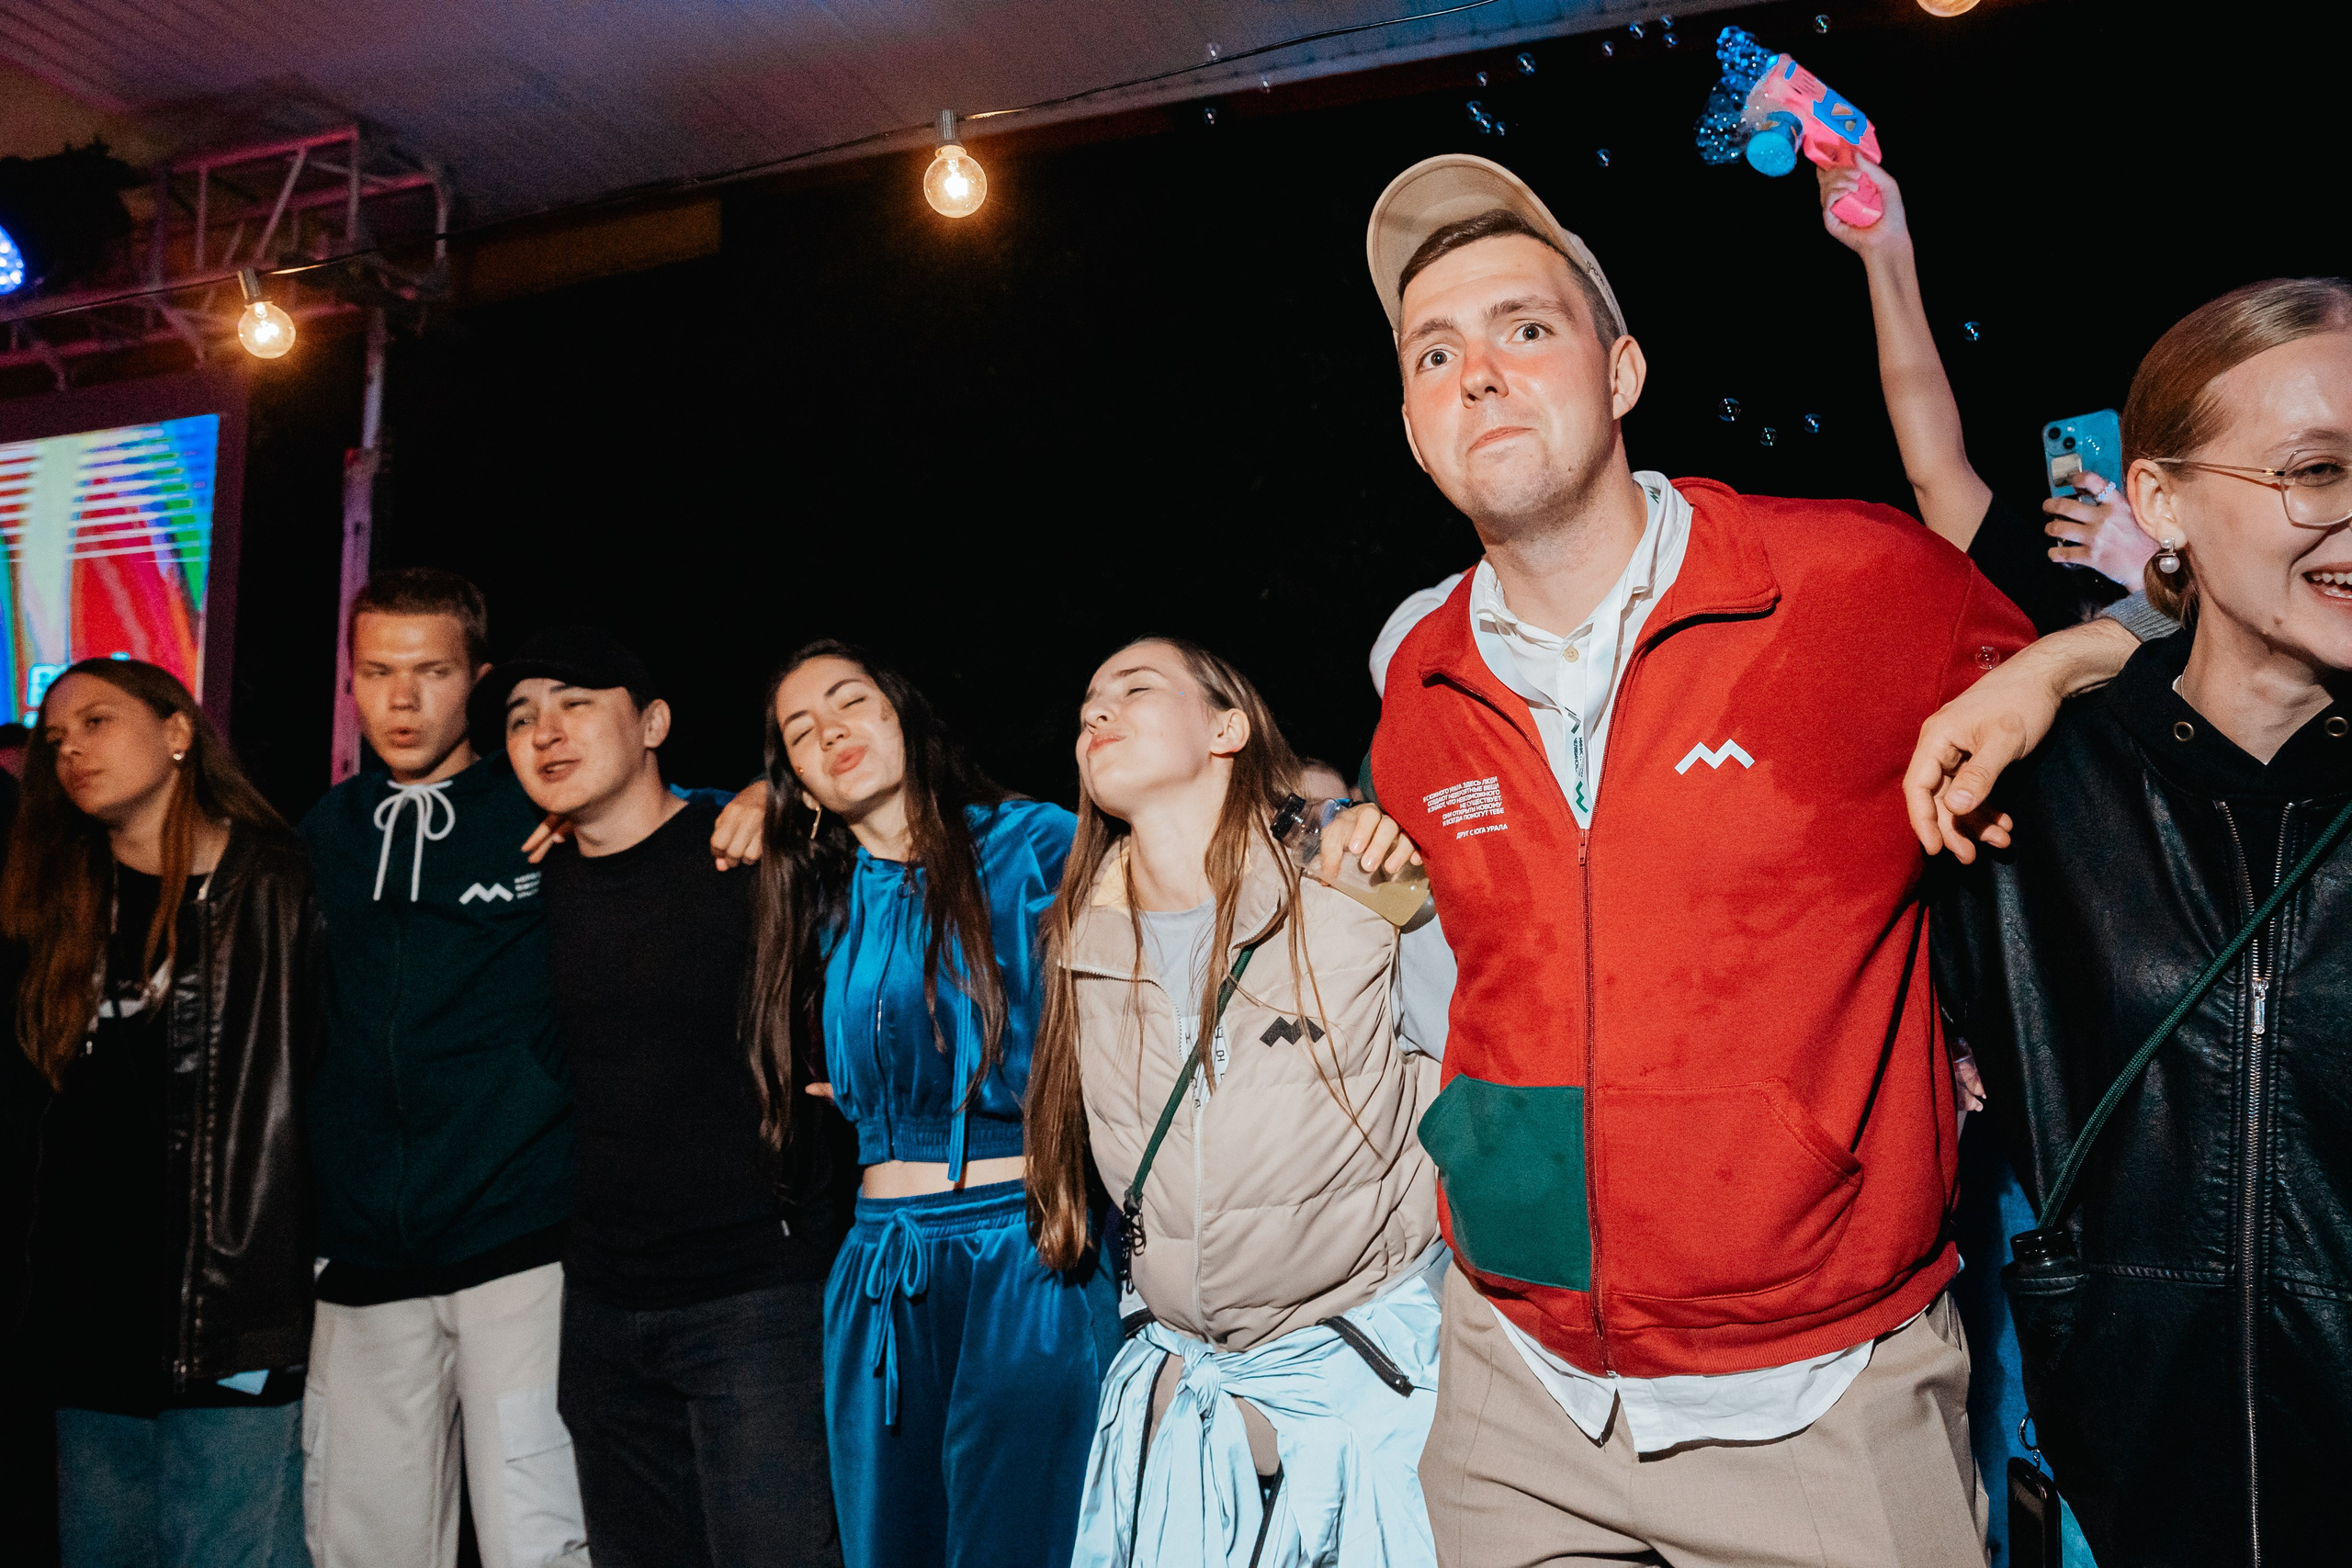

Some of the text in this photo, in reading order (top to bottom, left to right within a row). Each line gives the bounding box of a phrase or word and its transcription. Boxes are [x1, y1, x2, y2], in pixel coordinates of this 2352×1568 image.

[1463, 780, 1481, 788] ЗДЕСЬ
[1482, 776, 1498, 784] ЛЮДИ
[1448, 786, 1482, 799] НЕВЕРОЯТНЫЕ
[1484, 783, 1499, 791] ВЕЩИ
[1456, 789, 1500, 803] НЕВОЗМОЖНОГО
[1453, 807, 1476, 816] ОТКРЫТЫ
[1476, 801, 1502, 810] НОВОМУ
[1467, 795, 1502, 807] СУЩЕСТВУЕТ.
[1446, 816, 1464, 826] ВСЕГДА
[1464, 810, 1488, 819] ПОМОГУТ
[1456, 830, 1470, 840] ДРУГ
[1487, 824, 1508, 832] УРАЛА
